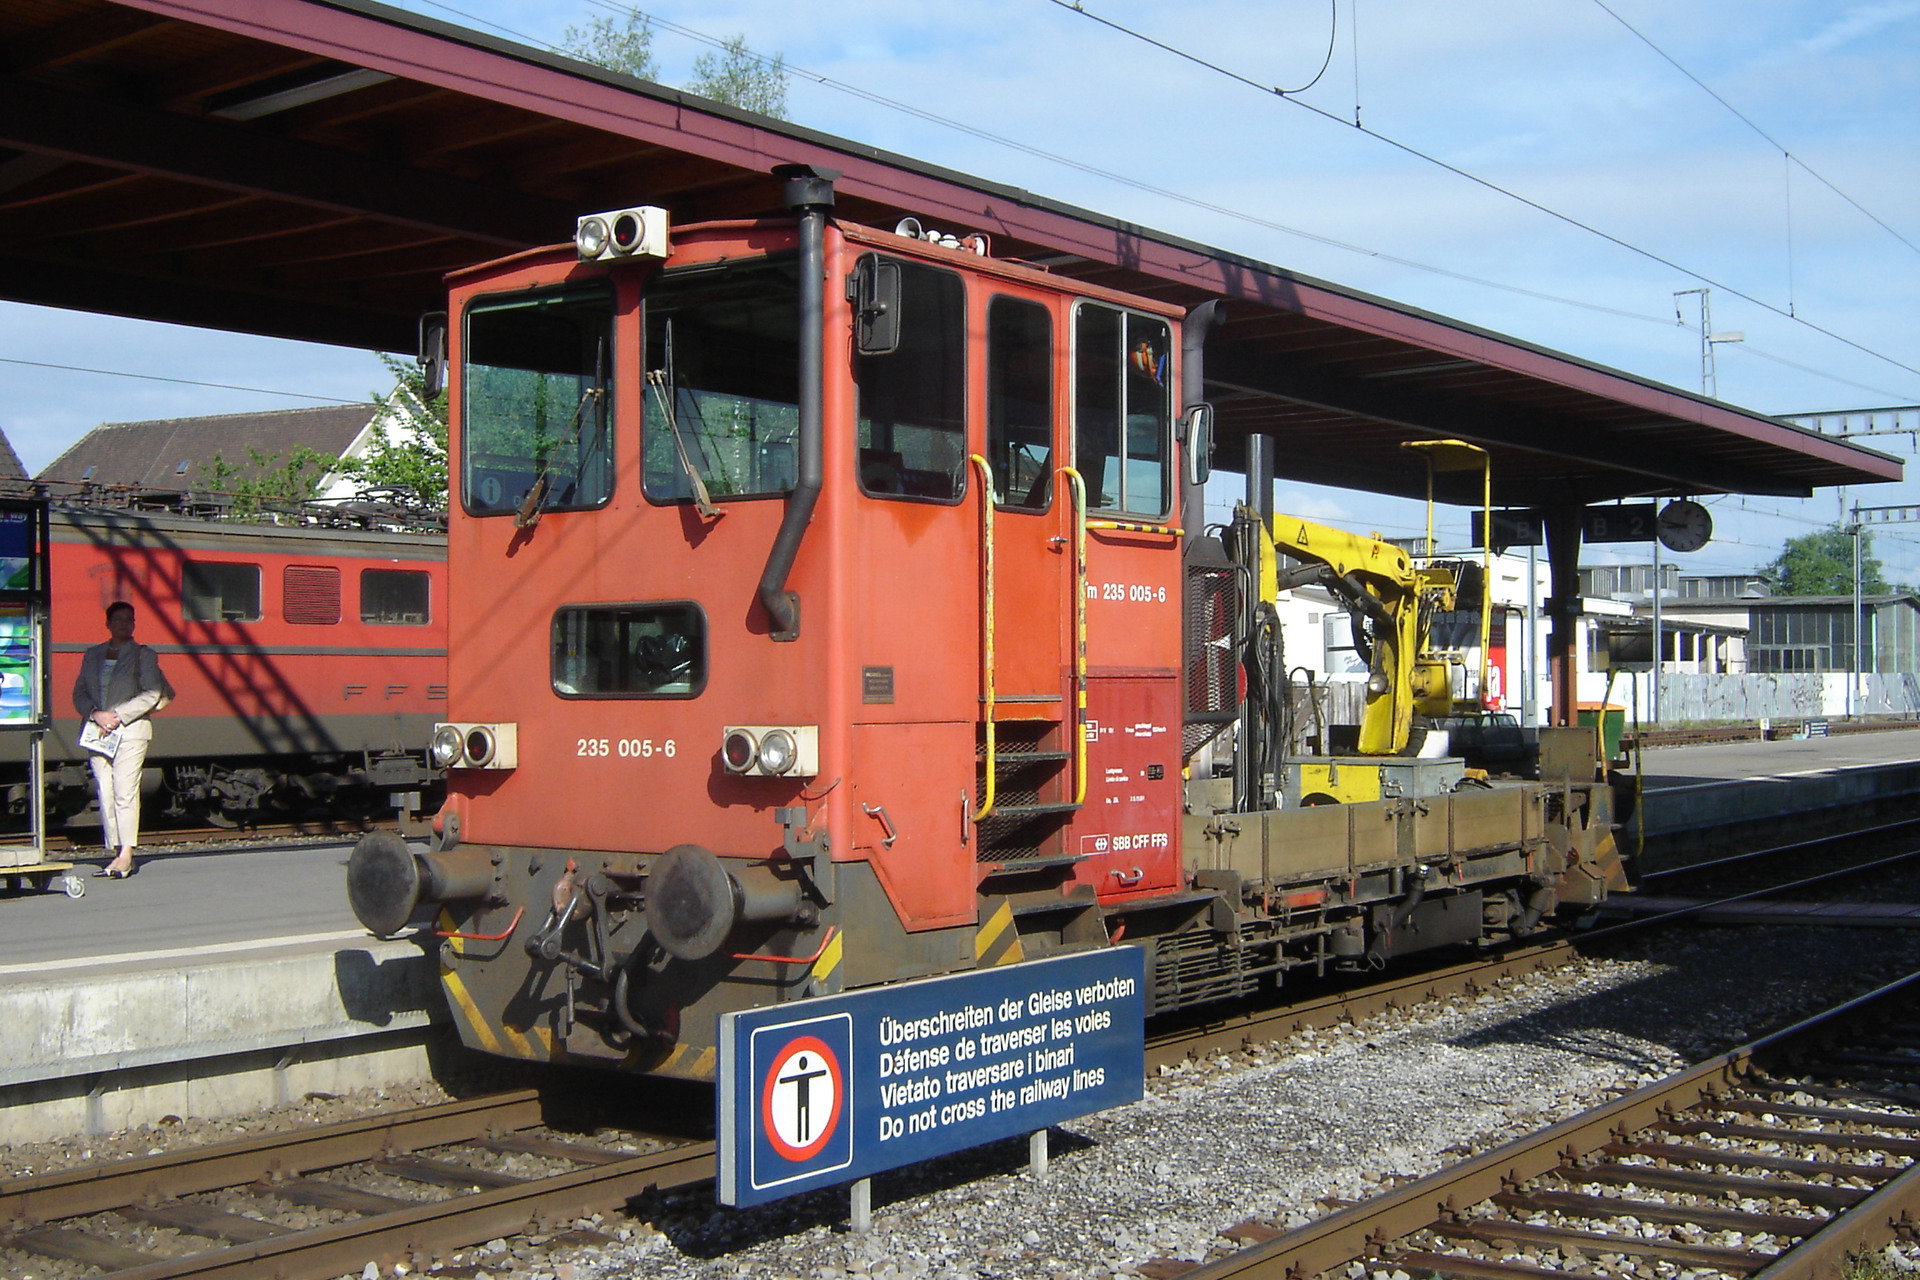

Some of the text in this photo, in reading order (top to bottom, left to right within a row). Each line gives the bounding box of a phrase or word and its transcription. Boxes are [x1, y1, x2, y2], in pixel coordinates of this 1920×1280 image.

[1630, 517, 1644, 536] 2
[1084, 581, 1166, 603] m 235 005-6
[577, 738, 676, 758] 235 005-6
[1112, 832, 1168, 851] SBB CFF FFS
[880, 976, 1135, 1046] Überschreiten der Gleise verboten
[880, 1010, 1111, 1078] Défense de traverser les voies
[881, 1043, 1074, 1109] Vietato traversare i binari
[879, 1067, 1105, 1142] Do not cross the railway lines
